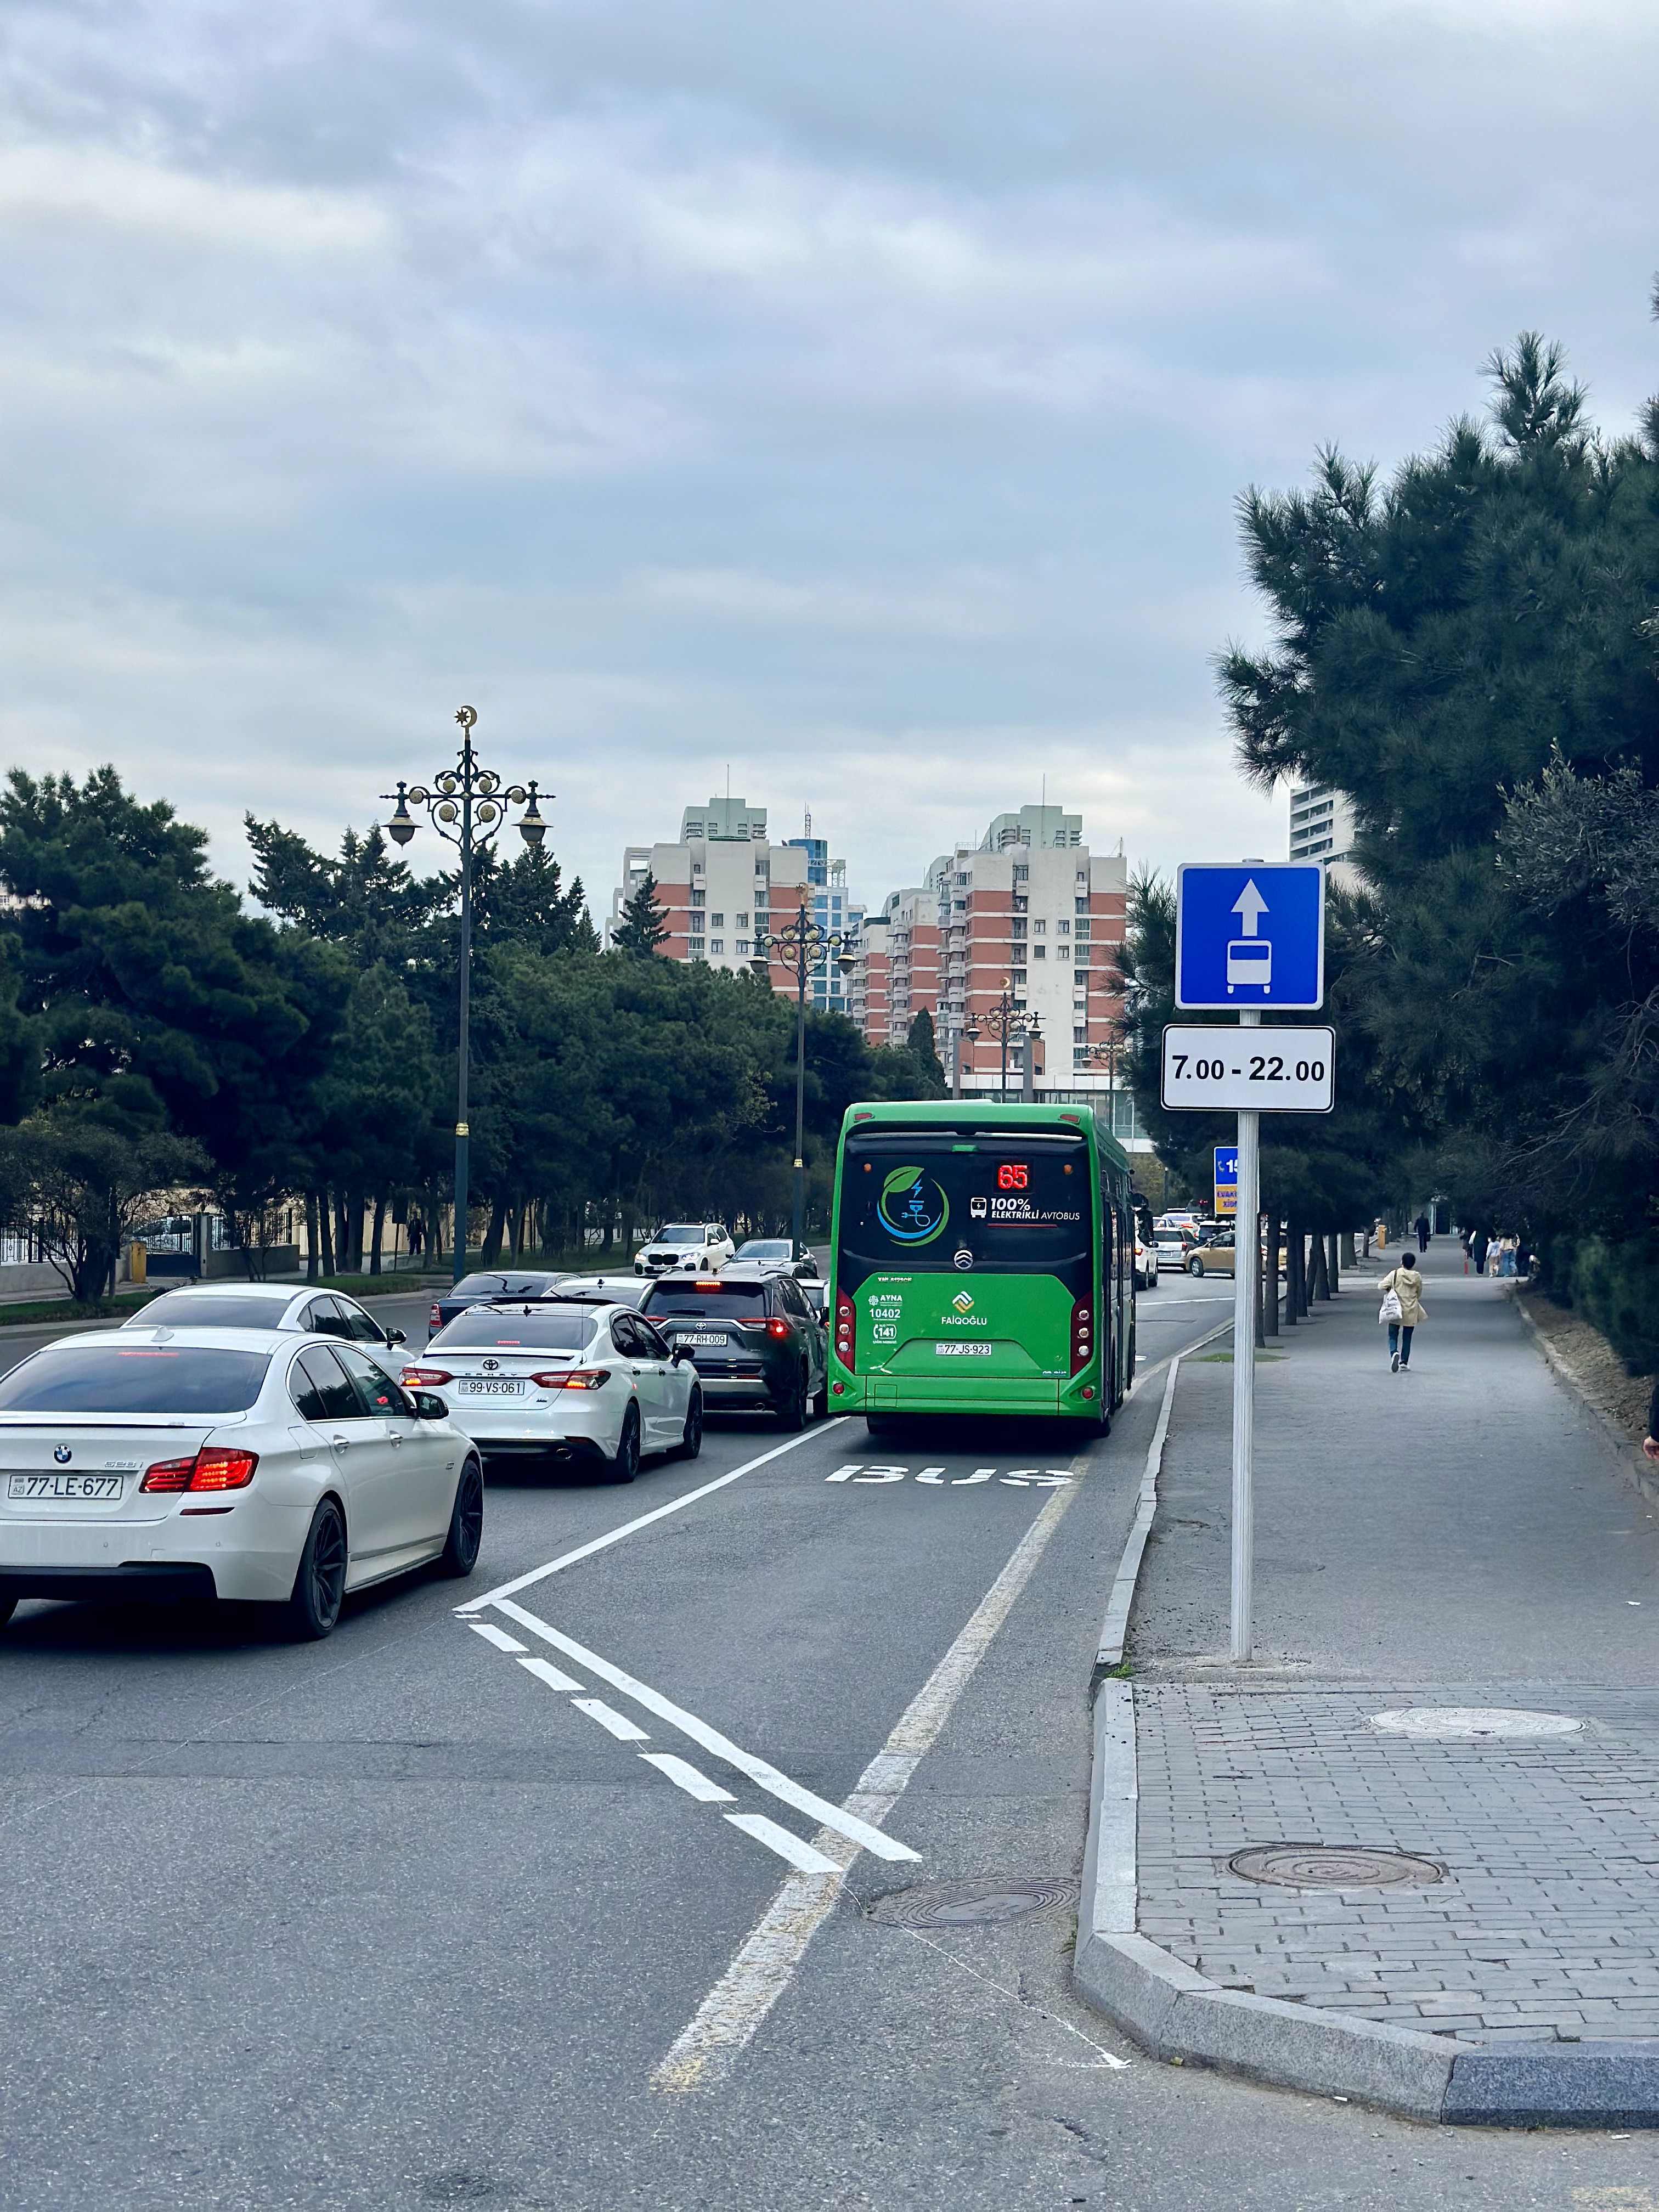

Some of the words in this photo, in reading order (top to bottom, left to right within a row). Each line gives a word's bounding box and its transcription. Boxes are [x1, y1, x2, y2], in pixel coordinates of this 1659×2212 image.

[1172, 1054, 1224, 1080] 7.00
[1249, 1056, 1325, 1081] 22.00
[997, 1164, 1028, 1189] 65
[990, 1198, 1031, 1211] 100%
[991, 1209, 1040, 1220] ELEKTRİKLİ
[1040, 1211, 1081, 1221] AVTOBUS
[869, 1308, 901, 1318] 10402
[941, 1315, 988, 1326] FAİQOĞLU
[878, 1327, 894, 1337] 141
[684, 1334, 725, 1344] 77-RH-009
[944, 1344, 990, 1355] 77-JS-923
[469, 1381, 521, 1394] 99-VS-061
[824, 1465, 1074, 1487] BUS
[26, 1477, 119, 1497] 77-LE-677
